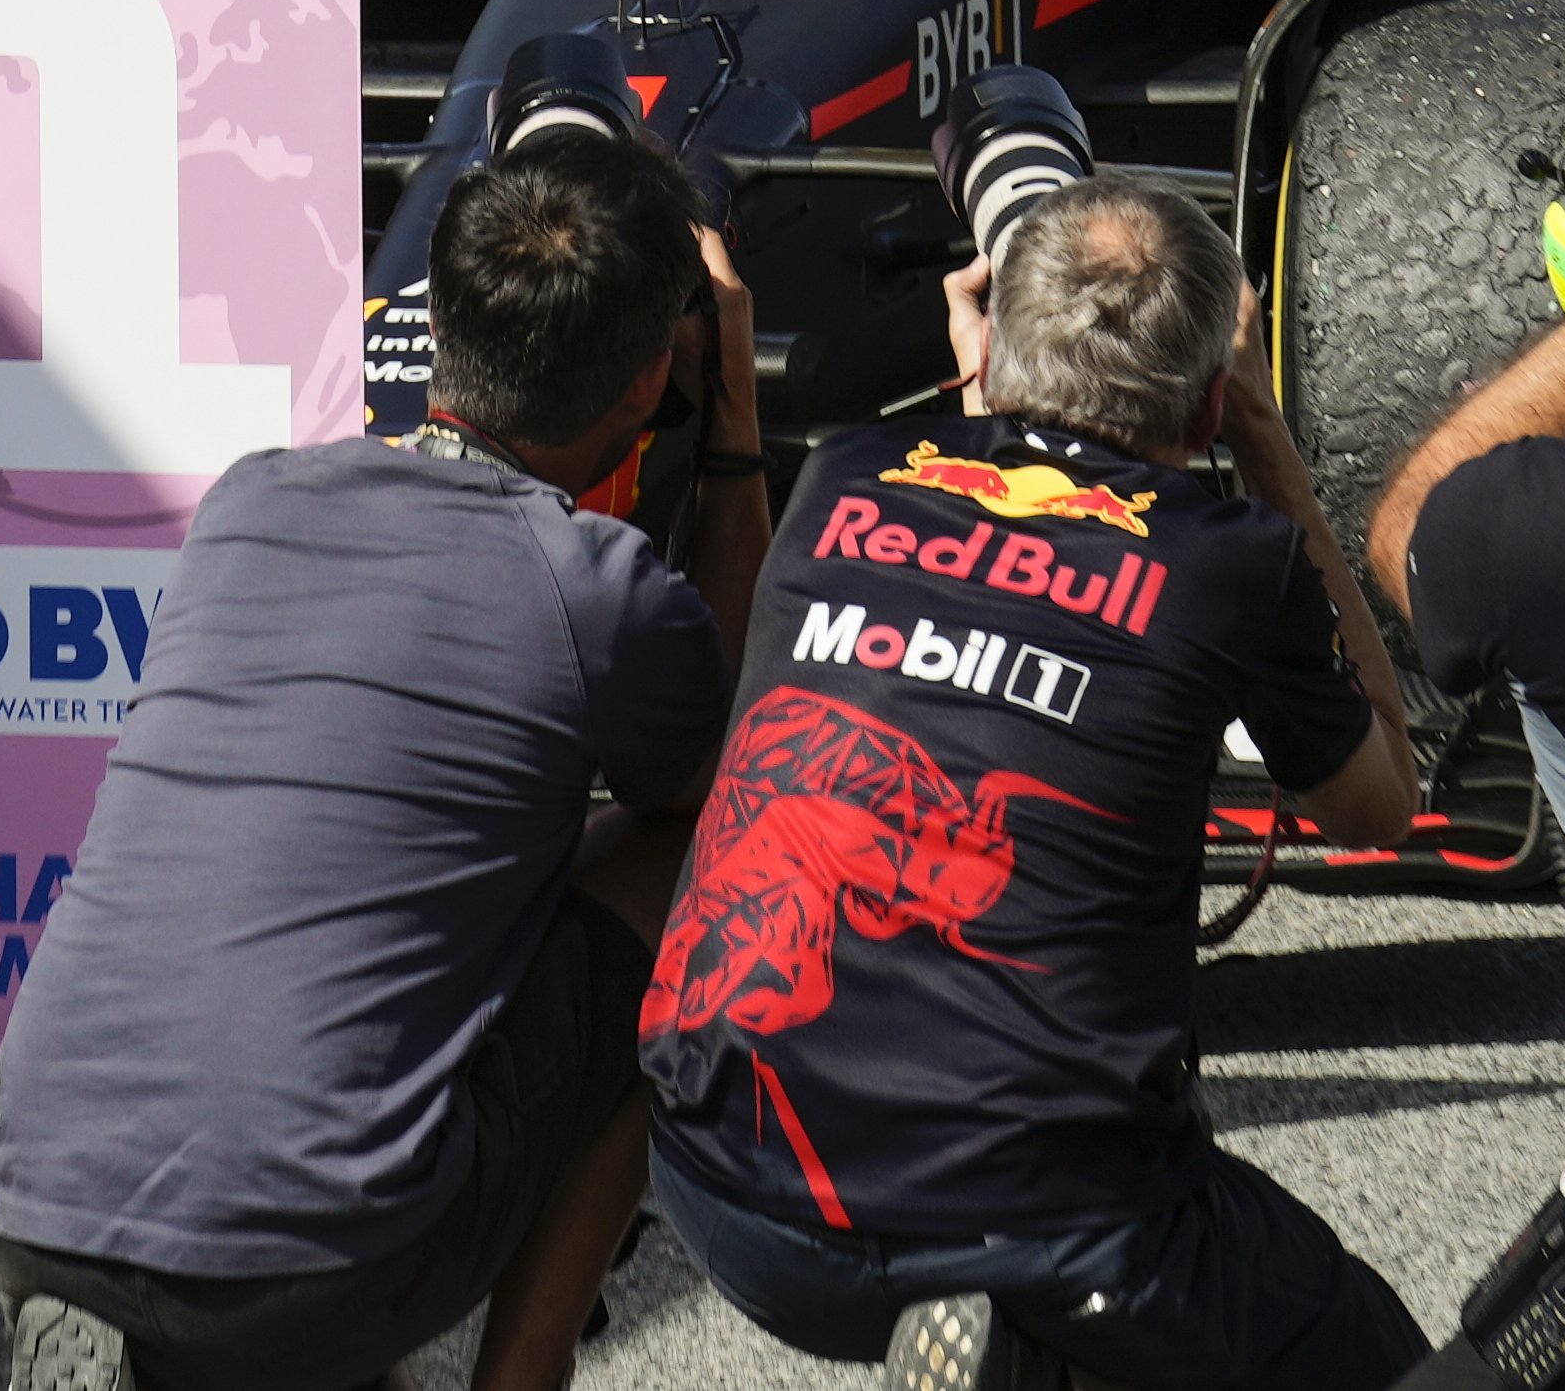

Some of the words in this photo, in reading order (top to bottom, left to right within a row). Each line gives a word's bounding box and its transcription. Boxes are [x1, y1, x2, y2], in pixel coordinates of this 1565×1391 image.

[811, 495, 990, 581] Red
[987, 533, 1169, 638] Bull
[29, 585, 164, 682] BW
[791, 600, 1009, 696] Mobil
